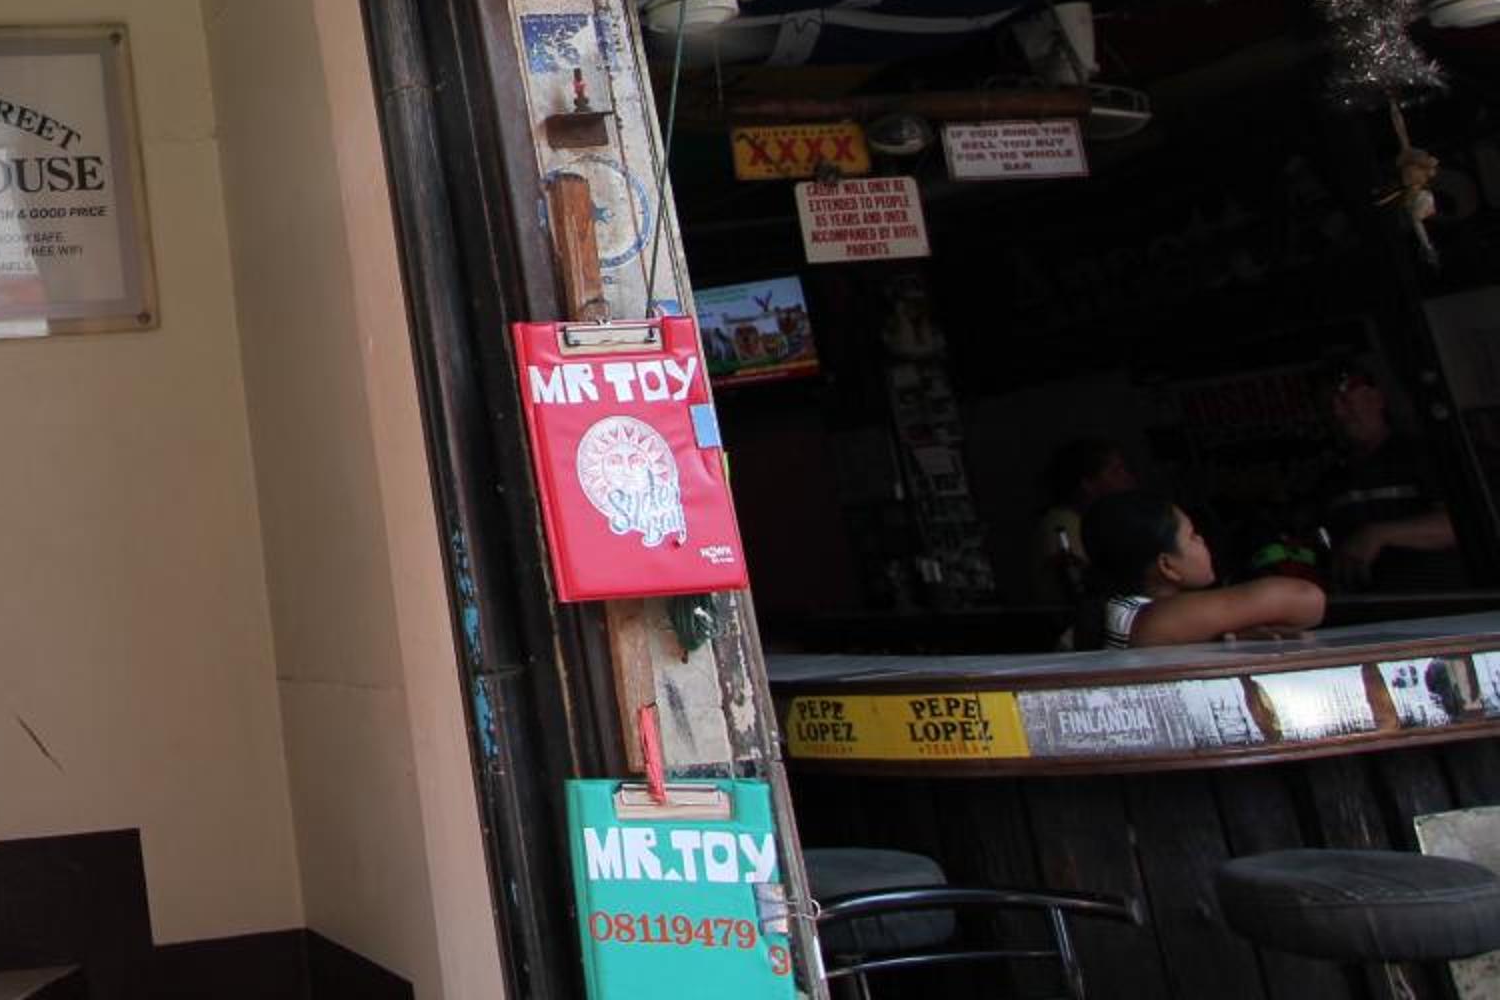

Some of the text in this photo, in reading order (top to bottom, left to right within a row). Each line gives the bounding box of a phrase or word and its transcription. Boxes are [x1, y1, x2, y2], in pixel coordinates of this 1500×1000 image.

[747, 135, 856, 166] XXXX
[17, 208, 27, 219] &
[29, 207, 67, 219] GOOD
[68, 205, 108, 217] PRICE
[527, 357, 700, 406] MR TOY
[794, 696, 980, 721] PEPE PEPE
[1057, 705, 1153, 735] FINLANDIA
[794, 719, 994, 744] LOPEZ LOPEZ
[588, 910, 757, 951] 08119479
